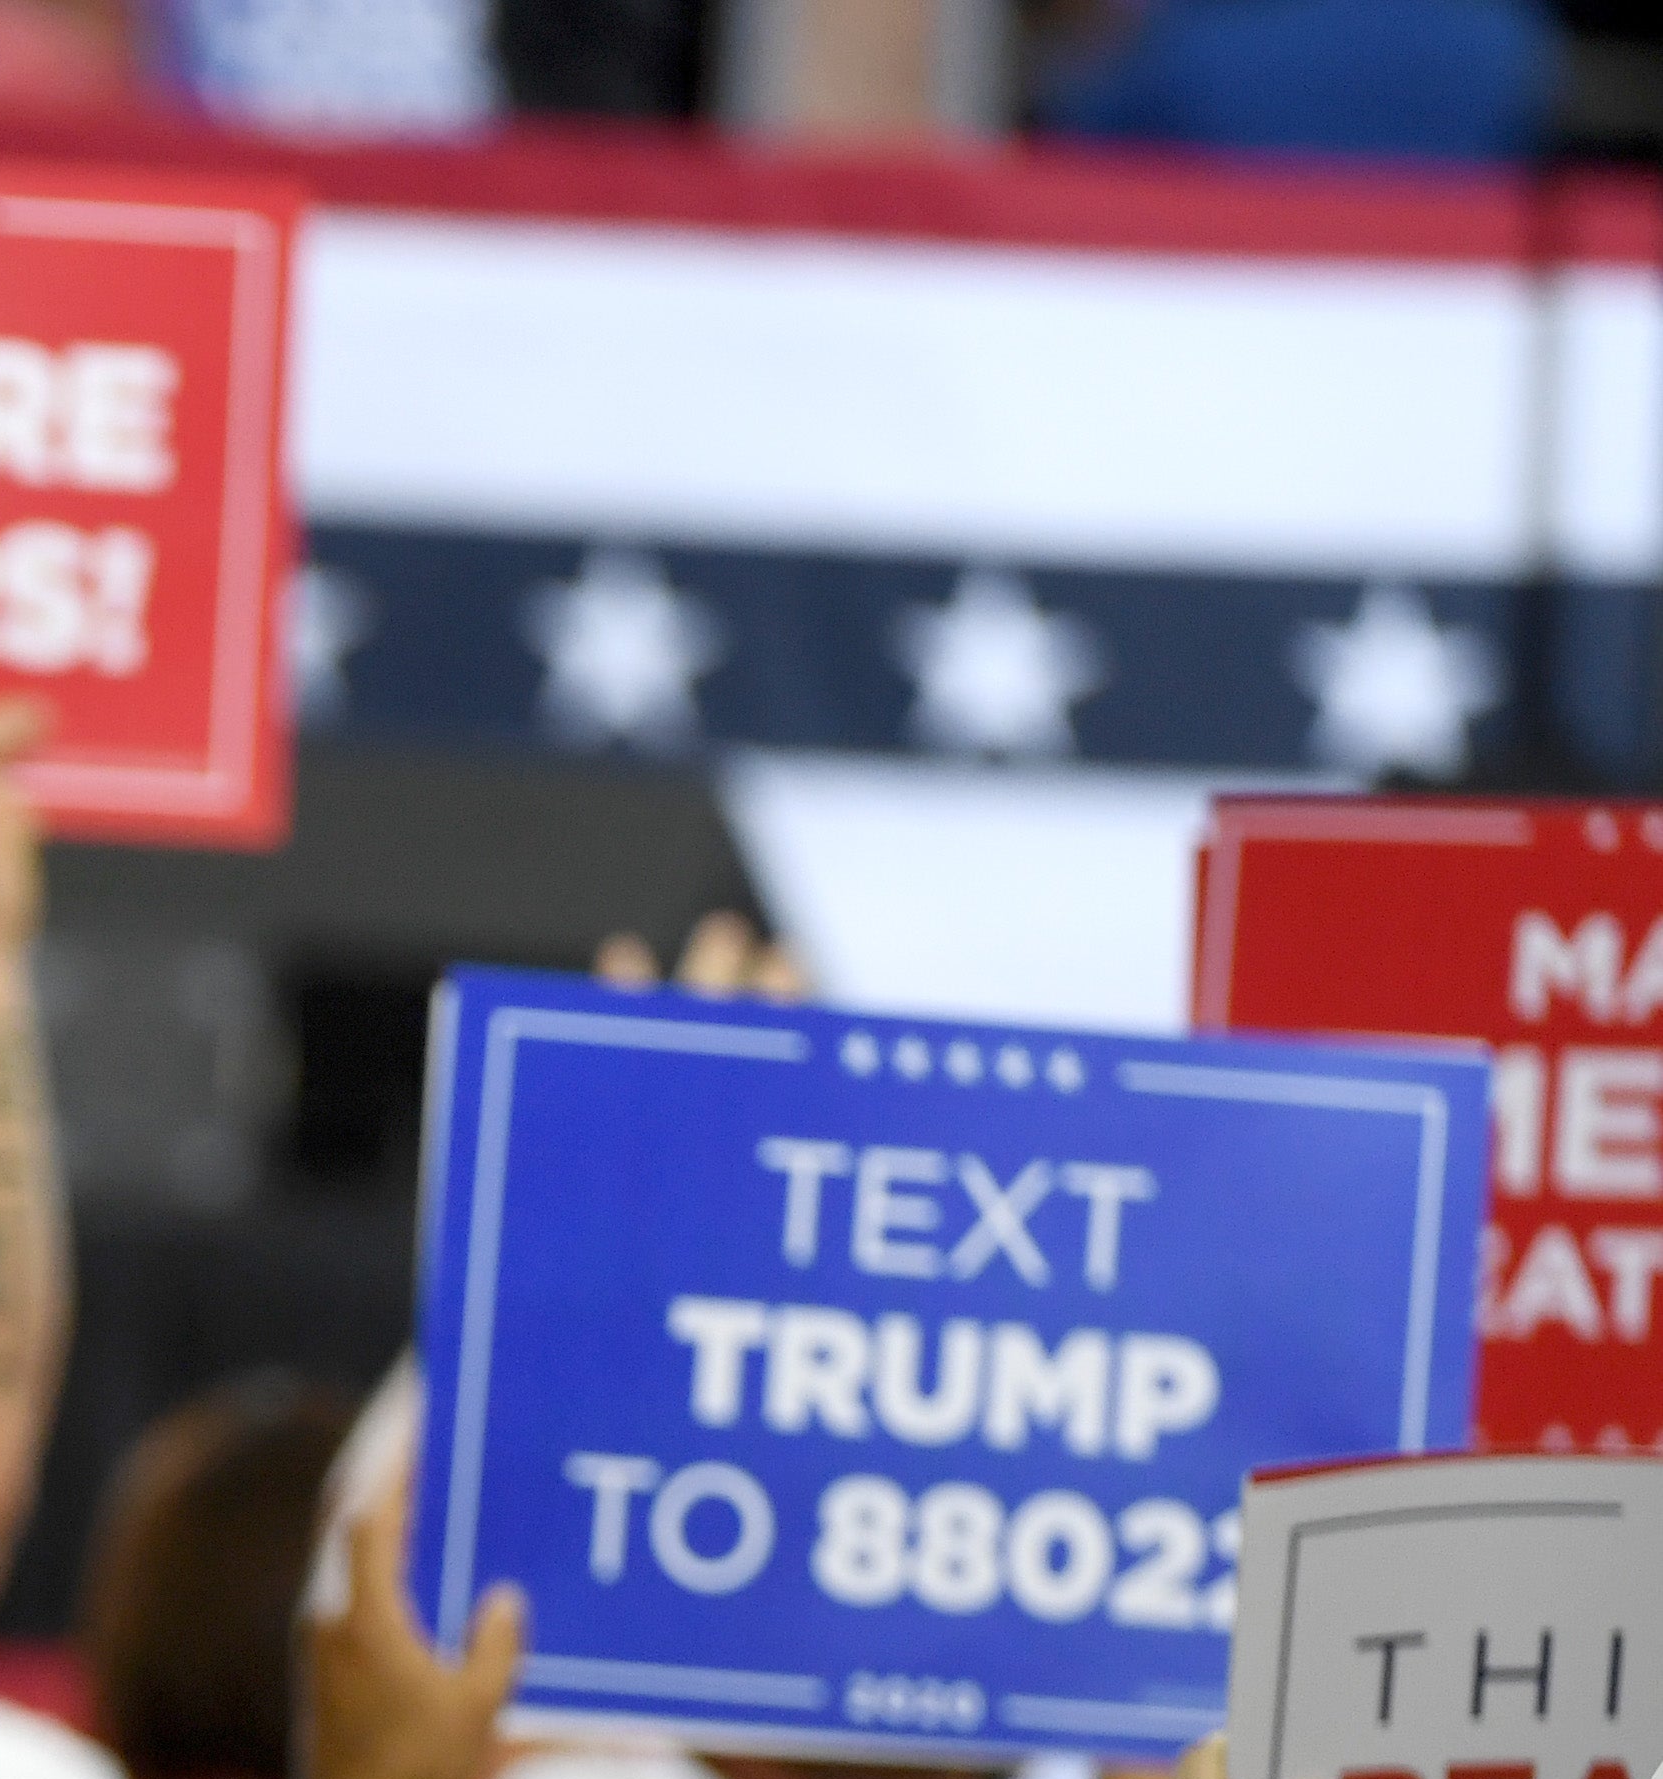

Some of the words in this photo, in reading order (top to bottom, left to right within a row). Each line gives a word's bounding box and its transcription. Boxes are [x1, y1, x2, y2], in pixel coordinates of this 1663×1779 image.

[757, 1136, 1157, 1290] TEXT
[668, 1295, 1221, 1459] TRUMP
[563, 1451, 777, 1596] TO
